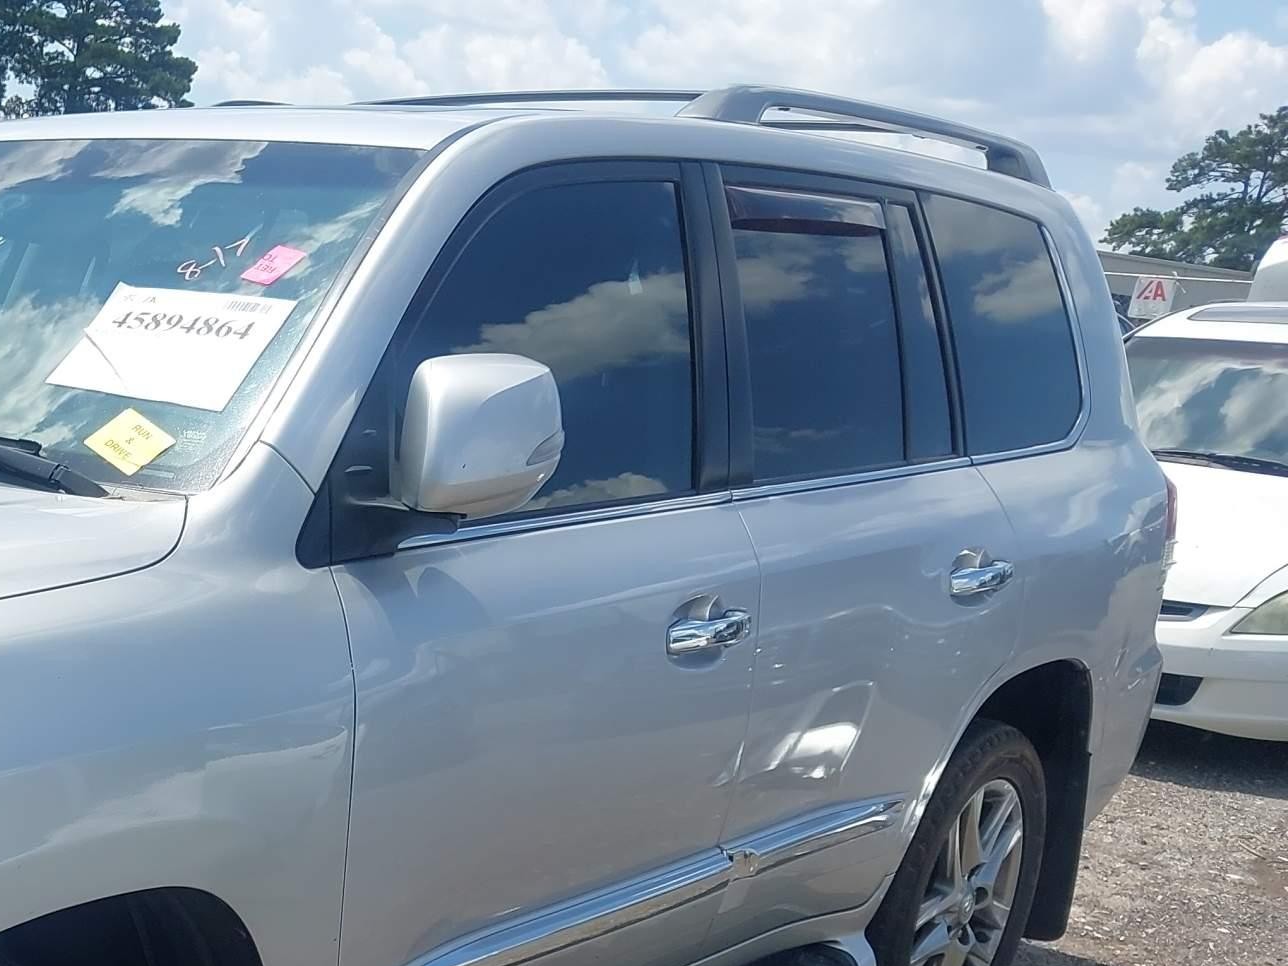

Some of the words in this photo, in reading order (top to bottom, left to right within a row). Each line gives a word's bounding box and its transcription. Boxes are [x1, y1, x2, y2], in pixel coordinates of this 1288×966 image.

[112, 311, 256, 340] 45894864
[132, 424, 153, 441] RUN
[104, 439, 133, 461] DRIVE
